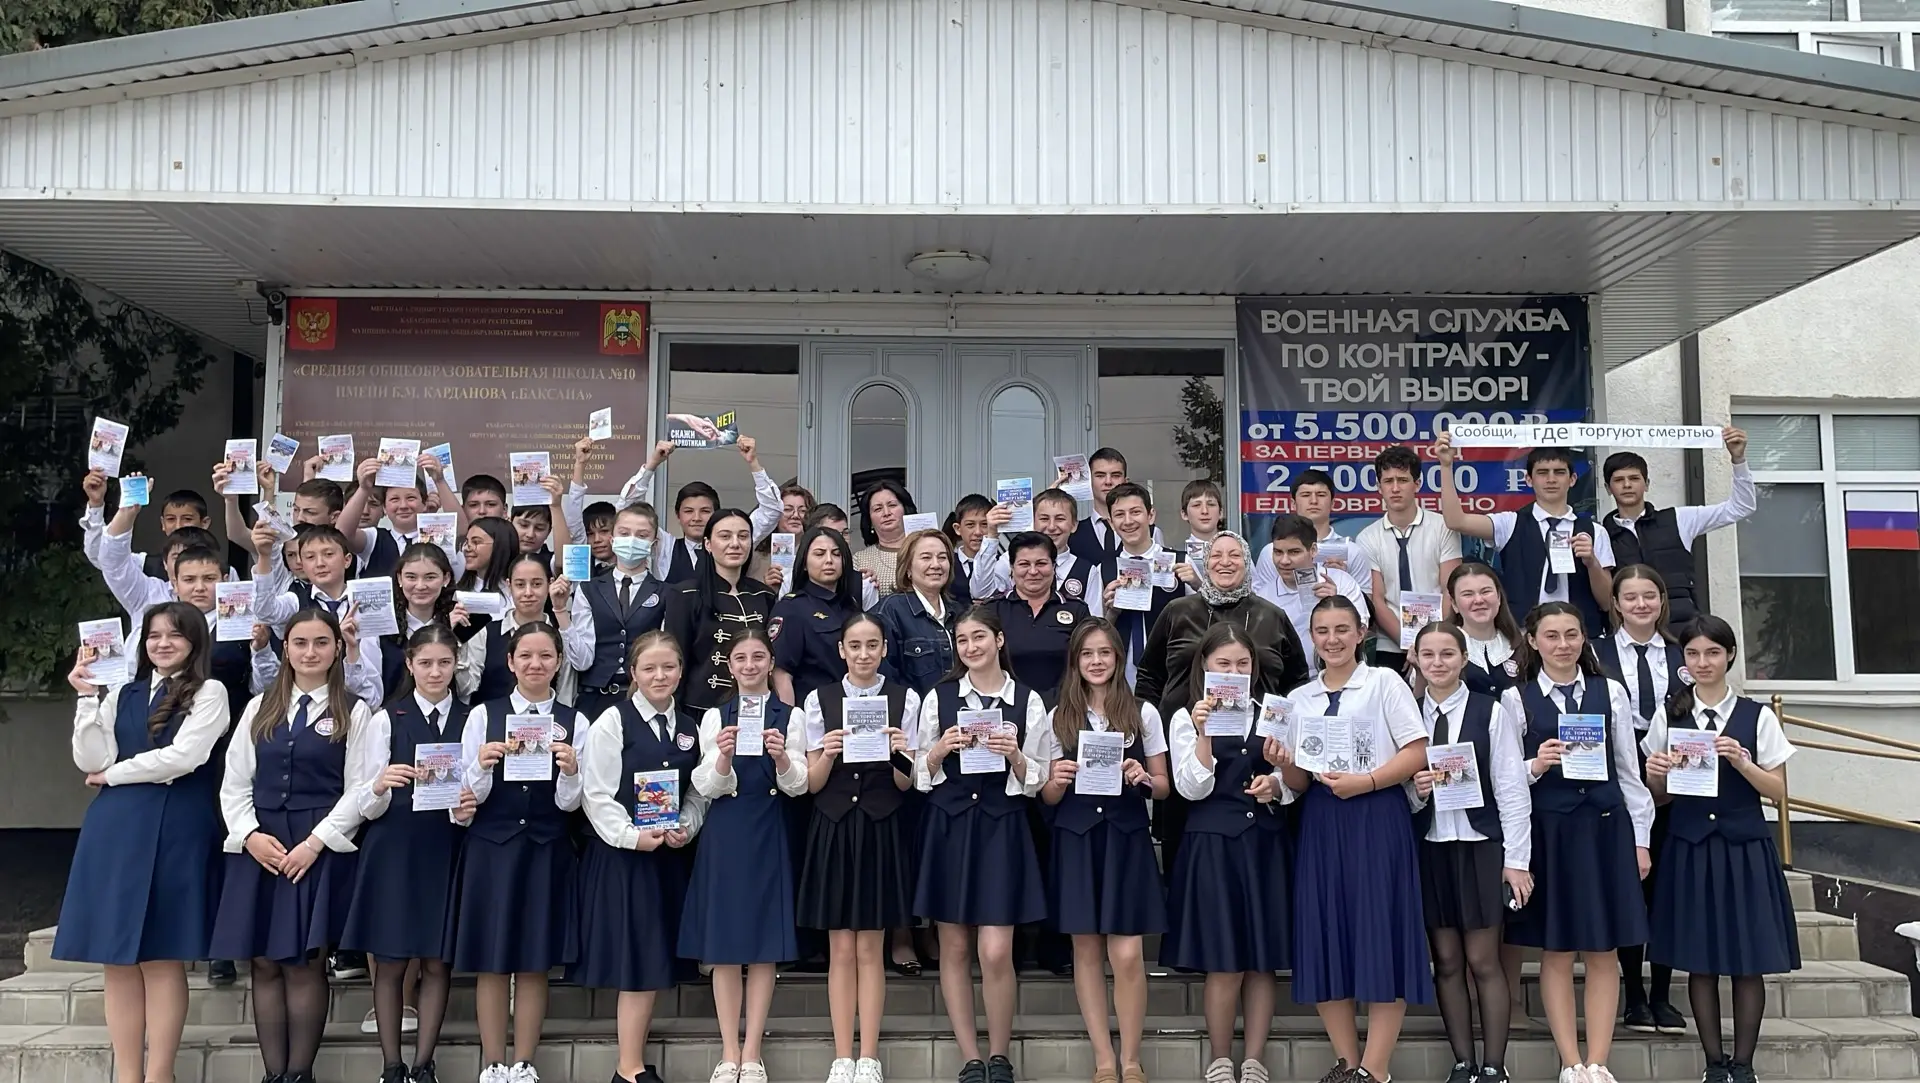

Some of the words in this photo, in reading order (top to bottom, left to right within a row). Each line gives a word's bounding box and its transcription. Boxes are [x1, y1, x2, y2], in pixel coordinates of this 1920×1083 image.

[1260, 308, 1420, 334] ВОЕННАЯ
[1428, 307, 1570, 333] СЛУЖБА
[1281, 343, 1330, 368] ПО
[1338, 341, 1530, 368] КОНТРАКТУ
[293, 363, 366, 377] «СРЕДНЯЯ
[369, 364, 548, 379] ОБЩЕОБРАЗОВАТЕЛЬНАЯ
[552, 367, 605, 380] ШКОЛА
[608, 368, 636, 380] №10
[336, 385, 388, 398] ИМЕНИ
[424, 386, 507, 400] КАРДАНОВА
[1300, 373, 1390, 403] ТВОЙ
[1400, 376, 1529, 402] ВЫБОР!
[670, 429, 696, 439] СКАЖИ
[1247, 423, 1285, 439] от
[1454, 425, 1517, 439] Сообщи,
[1533, 426, 1569, 443] где
[1578, 426, 1643, 440] торгуют
[1648, 428, 1715, 439] смертью
[1255, 444, 1289, 459] ЗА
[1296, 443, 1401, 459] ПЕРВЫ
[1266, 464, 1479, 493] 20000
[1256, 497, 1496, 514] ЕДОВРЕНО
